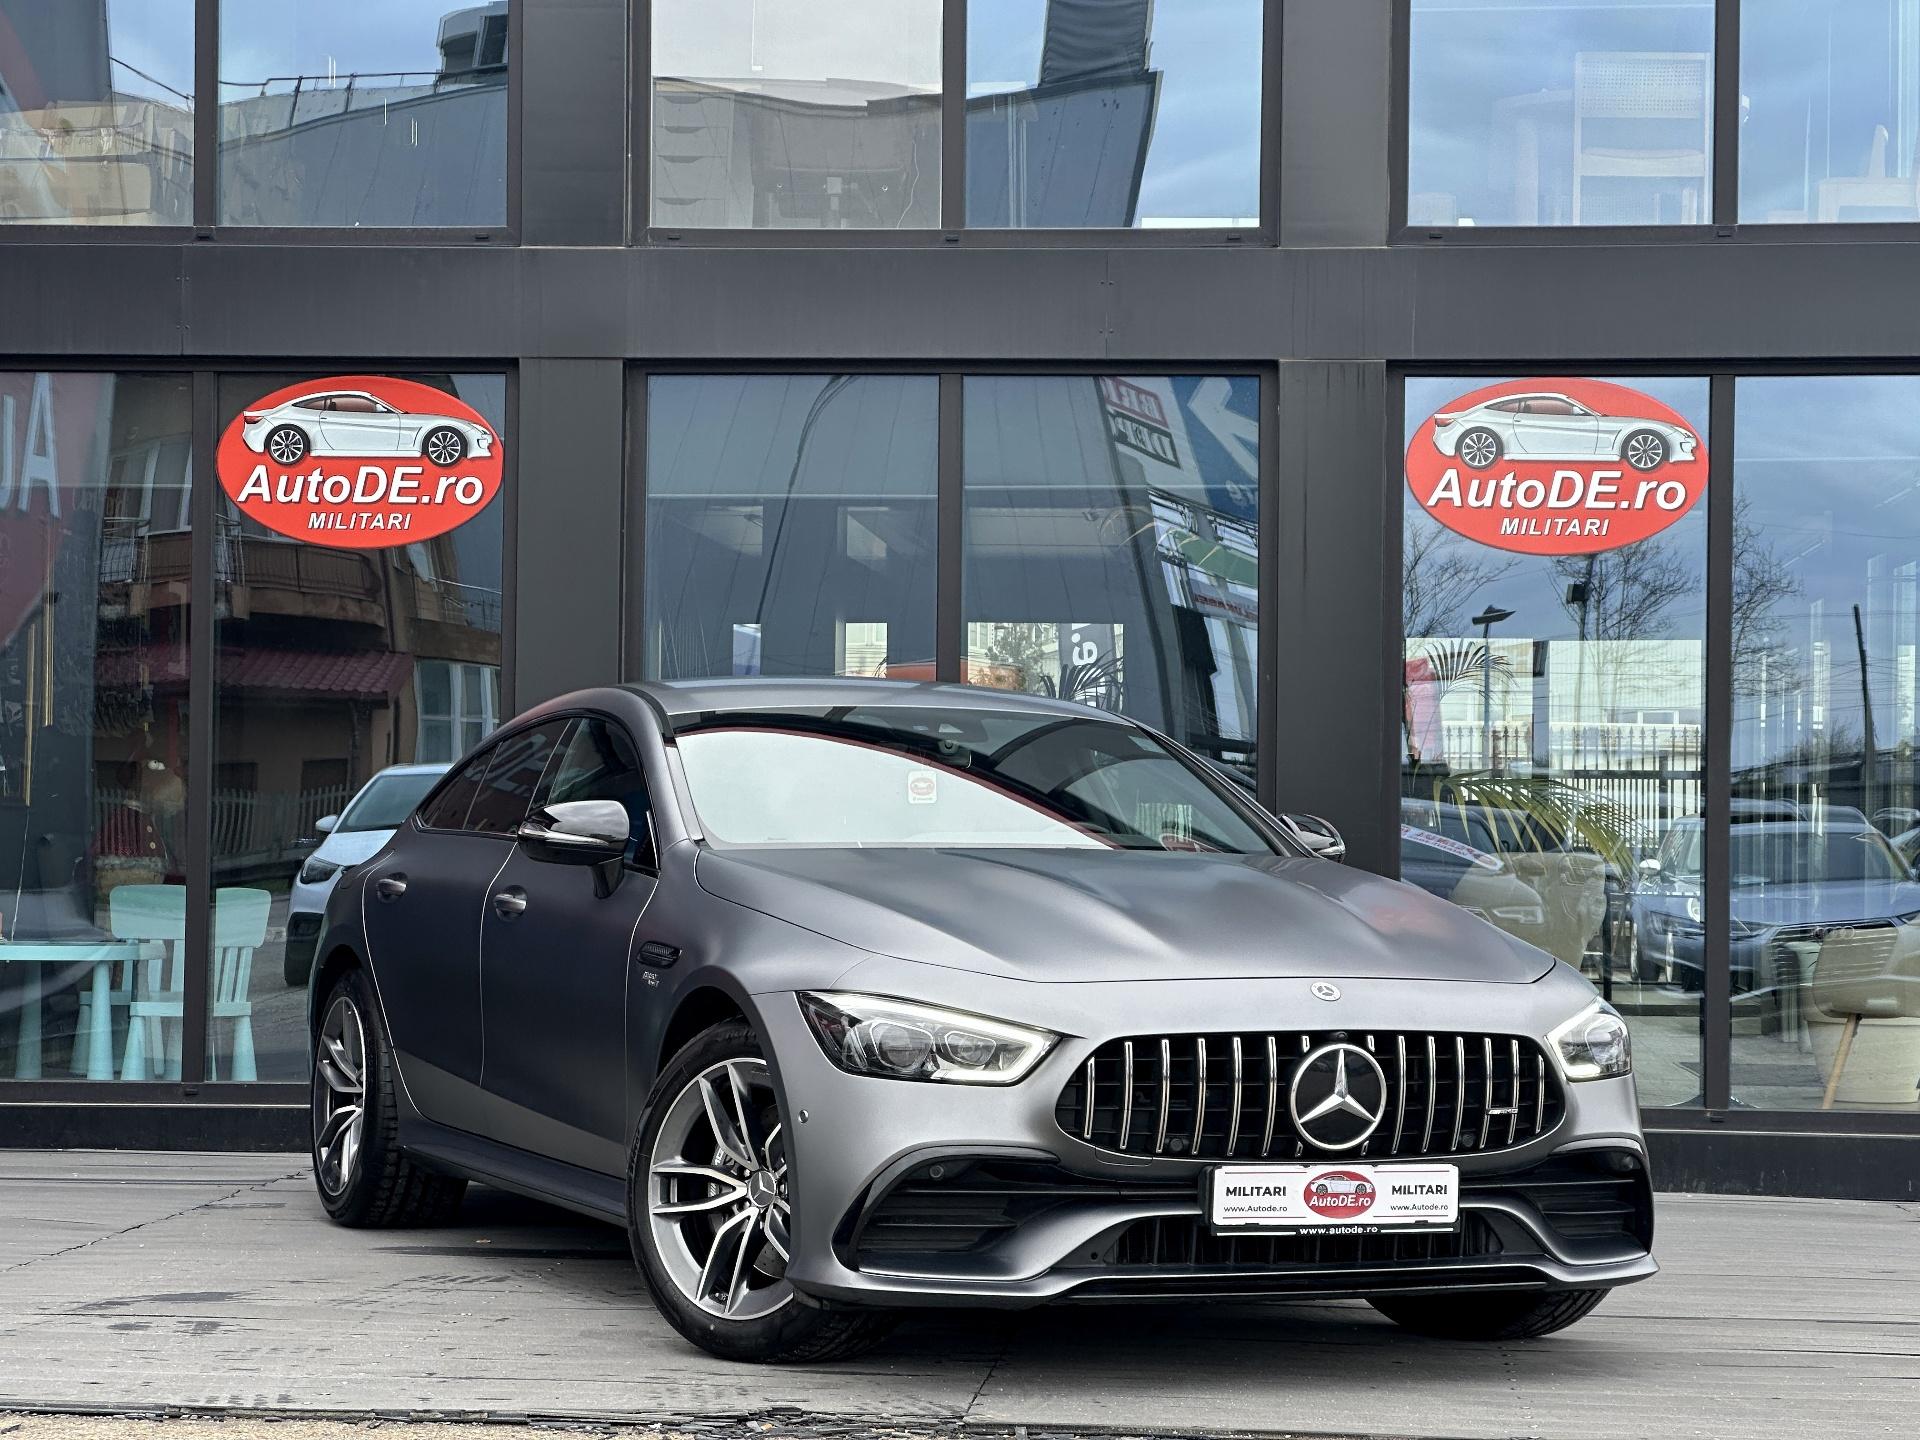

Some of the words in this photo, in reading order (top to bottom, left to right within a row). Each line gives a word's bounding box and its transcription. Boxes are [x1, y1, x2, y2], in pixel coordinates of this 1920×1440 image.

[237, 465, 484, 505] AutoDE.ro
[1426, 468, 1687, 511] AutoDE.ro
[307, 512, 412, 530] MILITARI
[1500, 518, 1610, 537] MILITARI
[1225, 1186, 1287, 1197] MILITARI
[1391, 1184, 1448, 1195] MILITARI
[1309, 1194, 1371, 1207] AutoDE.ro
[1223, 1205, 1288, 1213] www.Autode.ro
[1390, 1203, 1449, 1211] www.Autode.ro
[1300, 1226, 1379, 1235] www.autode.ro
